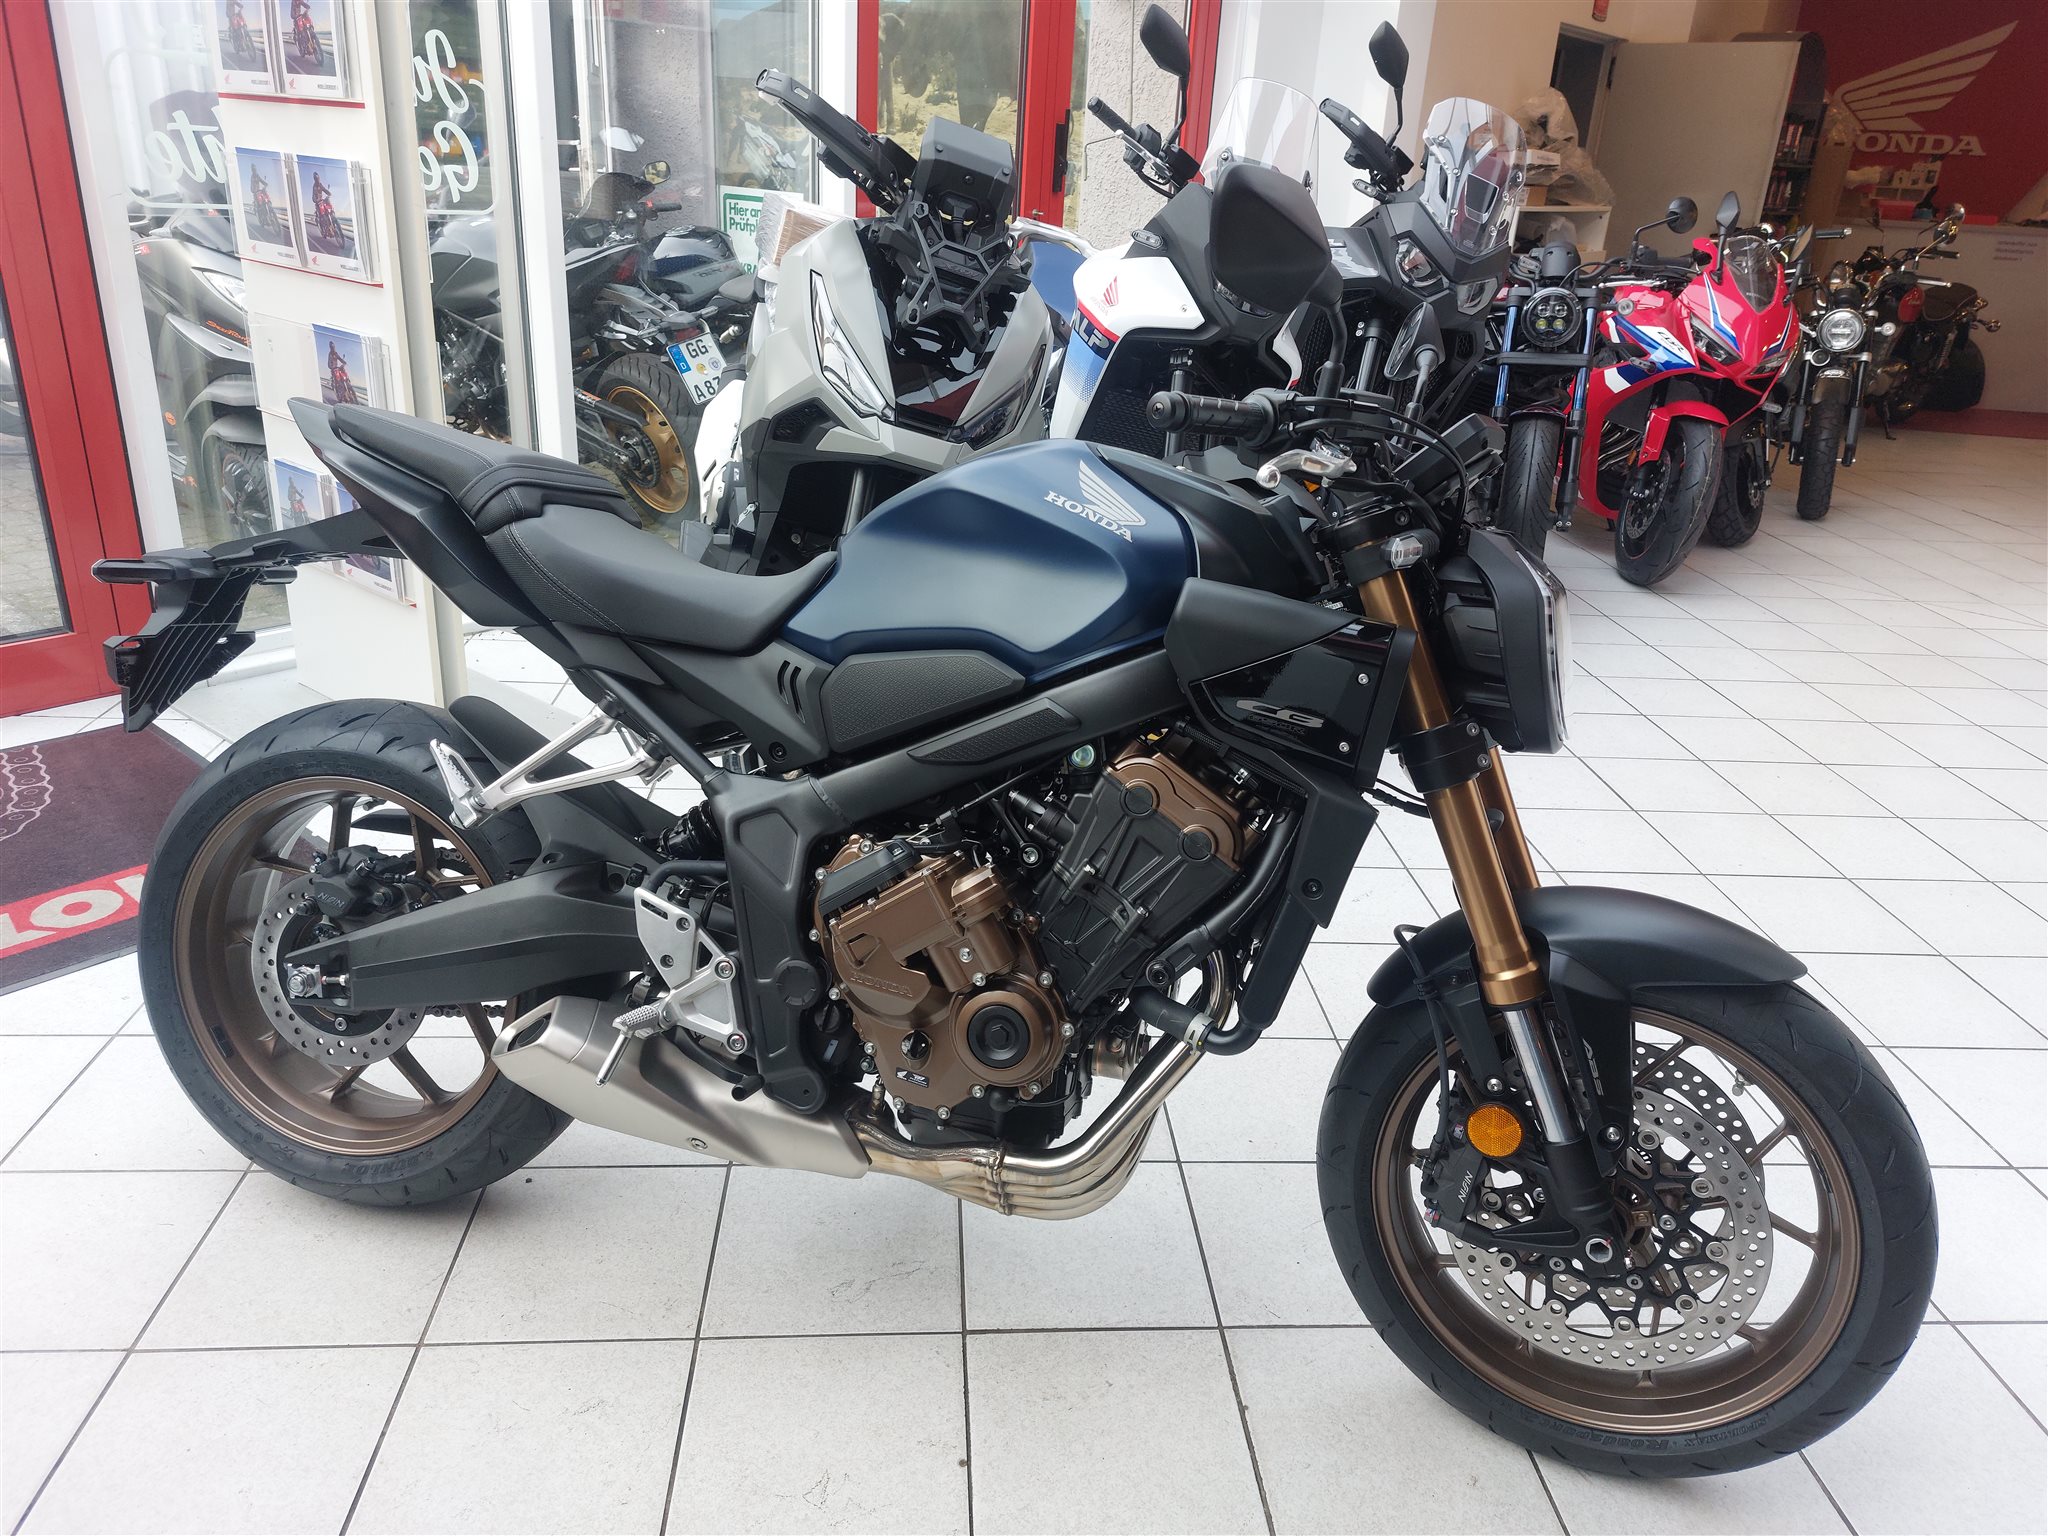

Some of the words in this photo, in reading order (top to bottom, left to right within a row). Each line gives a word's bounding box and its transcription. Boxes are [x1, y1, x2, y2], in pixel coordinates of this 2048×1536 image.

[729, 202, 749, 216] Hier
[686, 338, 709, 359] GG
[680, 362, 687, 370] D
[694, 384, 706, 401] A
[1044, 490, 1132, 543] HONDA
[1236, 699, 1324, 728] CB
[850, 970, 913, 998] HONDA
[1582, 1038, 1605, 1097] ABS
[1458, 1170, 1474, 1203] NISSIN
